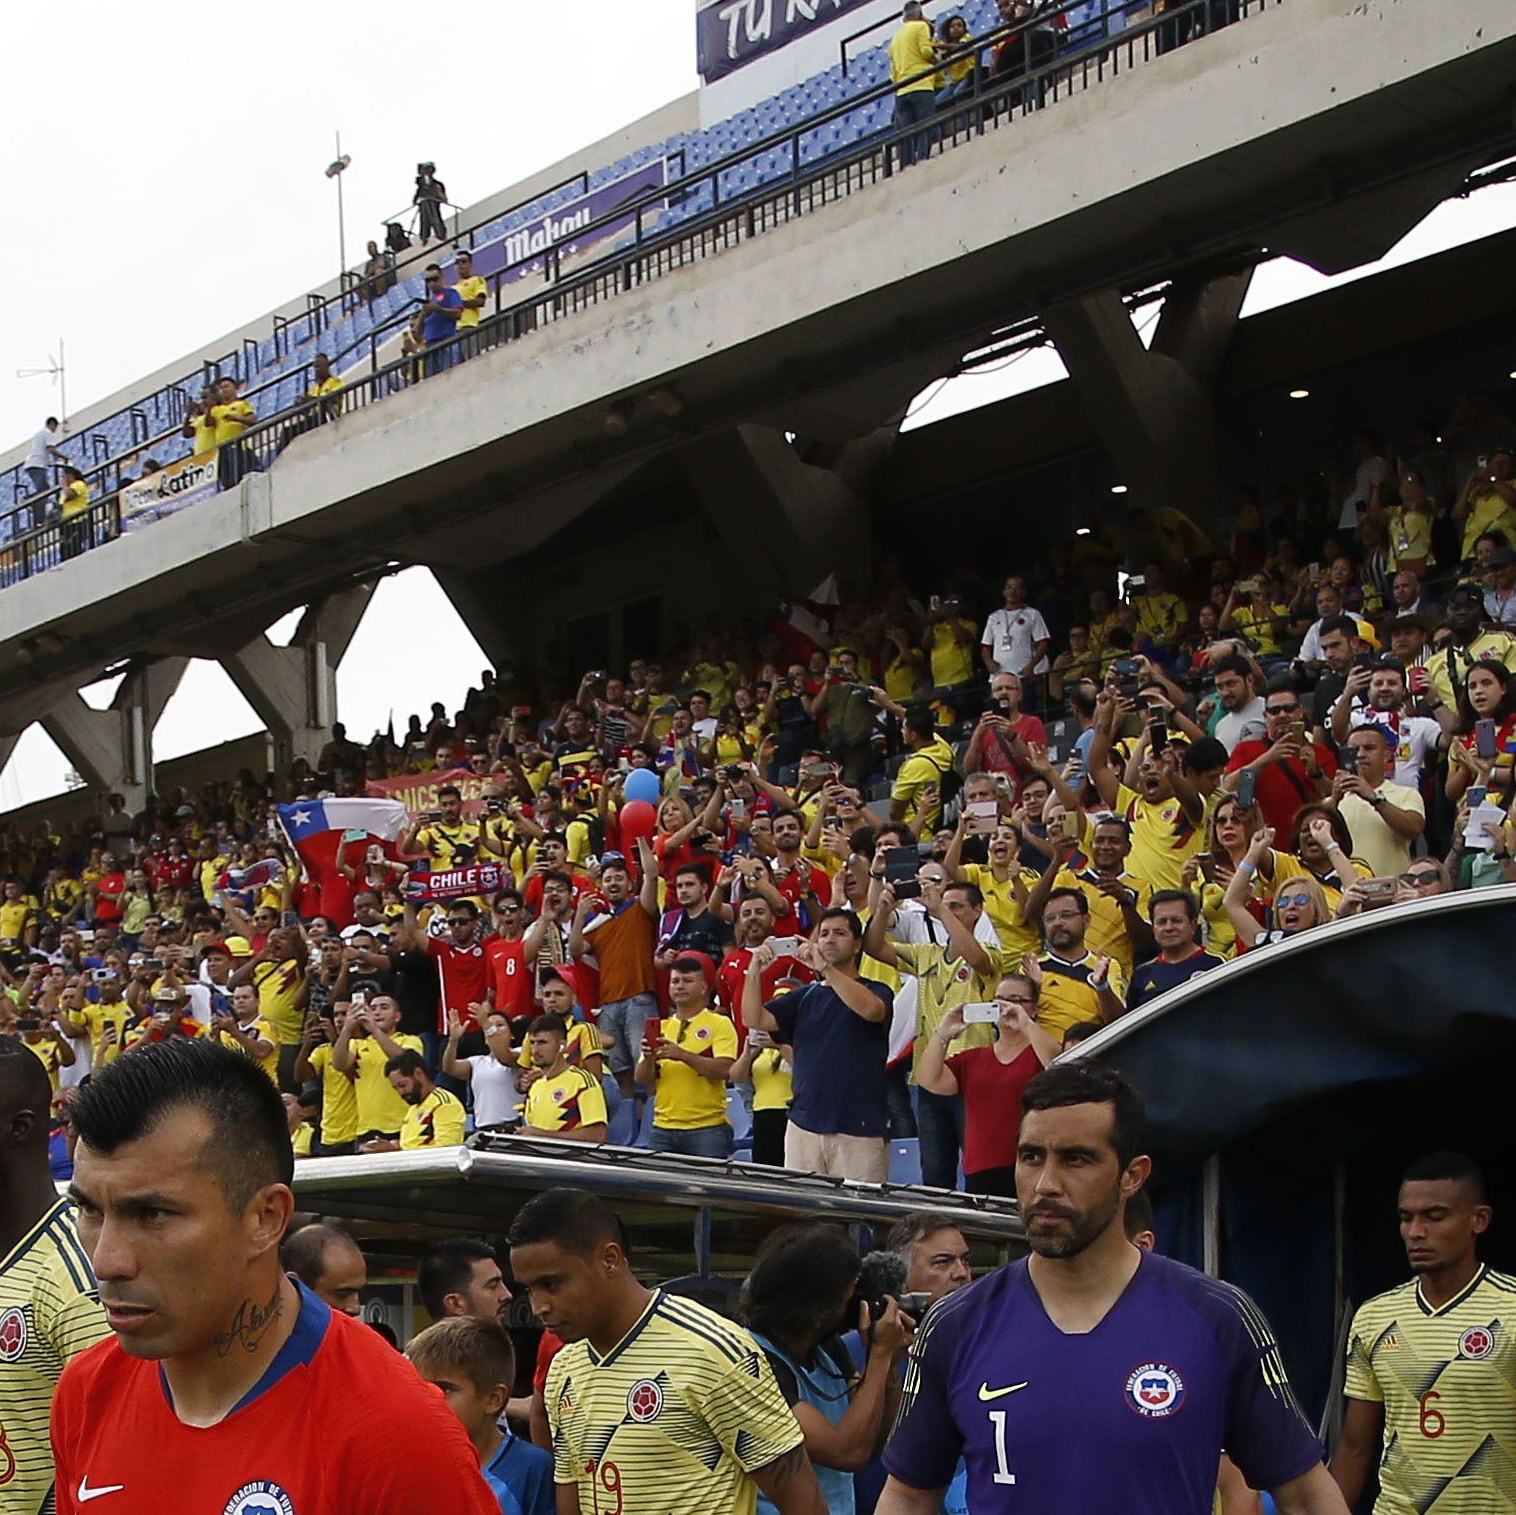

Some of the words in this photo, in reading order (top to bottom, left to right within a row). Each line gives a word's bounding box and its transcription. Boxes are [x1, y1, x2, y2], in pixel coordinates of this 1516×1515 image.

[430, 869, 477, 889] CHILE
[506, 957, 516, 976] 8
[1419, 1390, 1445, 1439] 6
[988, 1410, 1017, 1486] 1
[268, 1483, 281, 1497] DE
